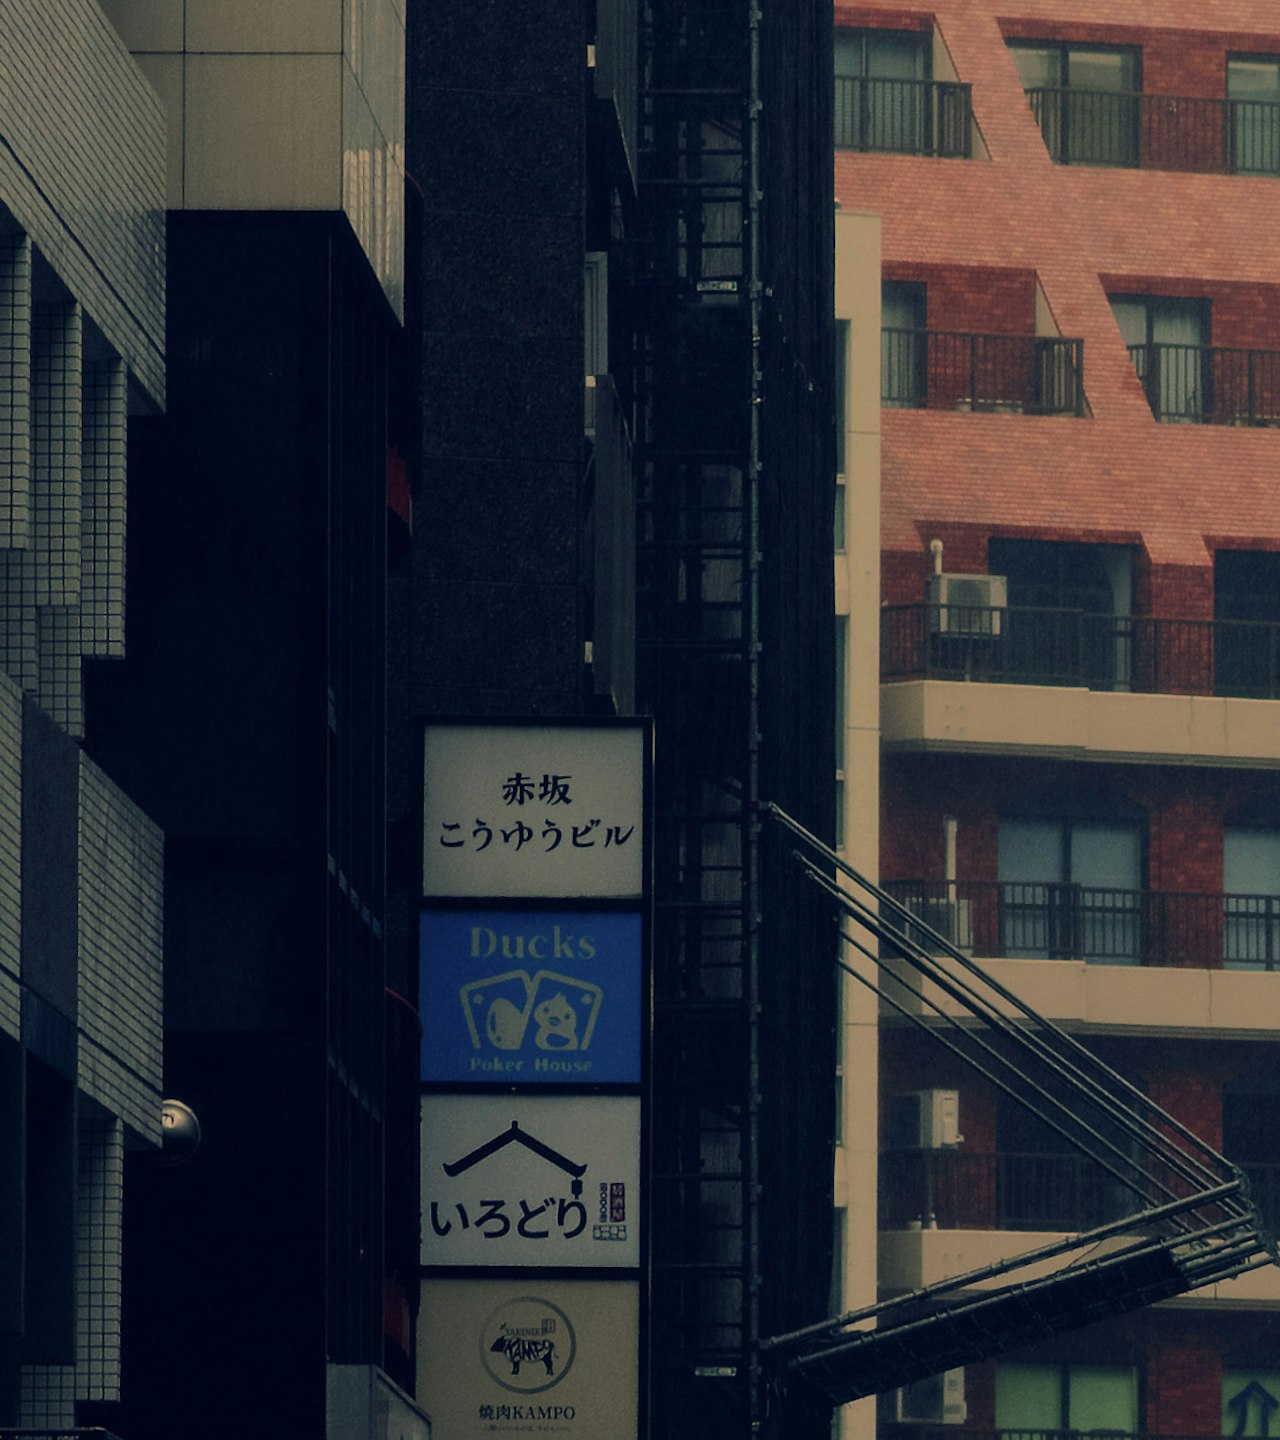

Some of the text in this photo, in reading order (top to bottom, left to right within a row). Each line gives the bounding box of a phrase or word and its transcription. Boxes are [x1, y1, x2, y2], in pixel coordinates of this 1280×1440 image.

[502, 772, 573, 806] 赤坂
[440, 817, 635, 852] こうゆうビル
[469, 924, 597, 960] Ducks
[469, 1056, 593, 1073] Poker House
[429, 1196, 588, 1240] いろどり
[479, 1404, 576, 1421] 焼肉KAMPO
